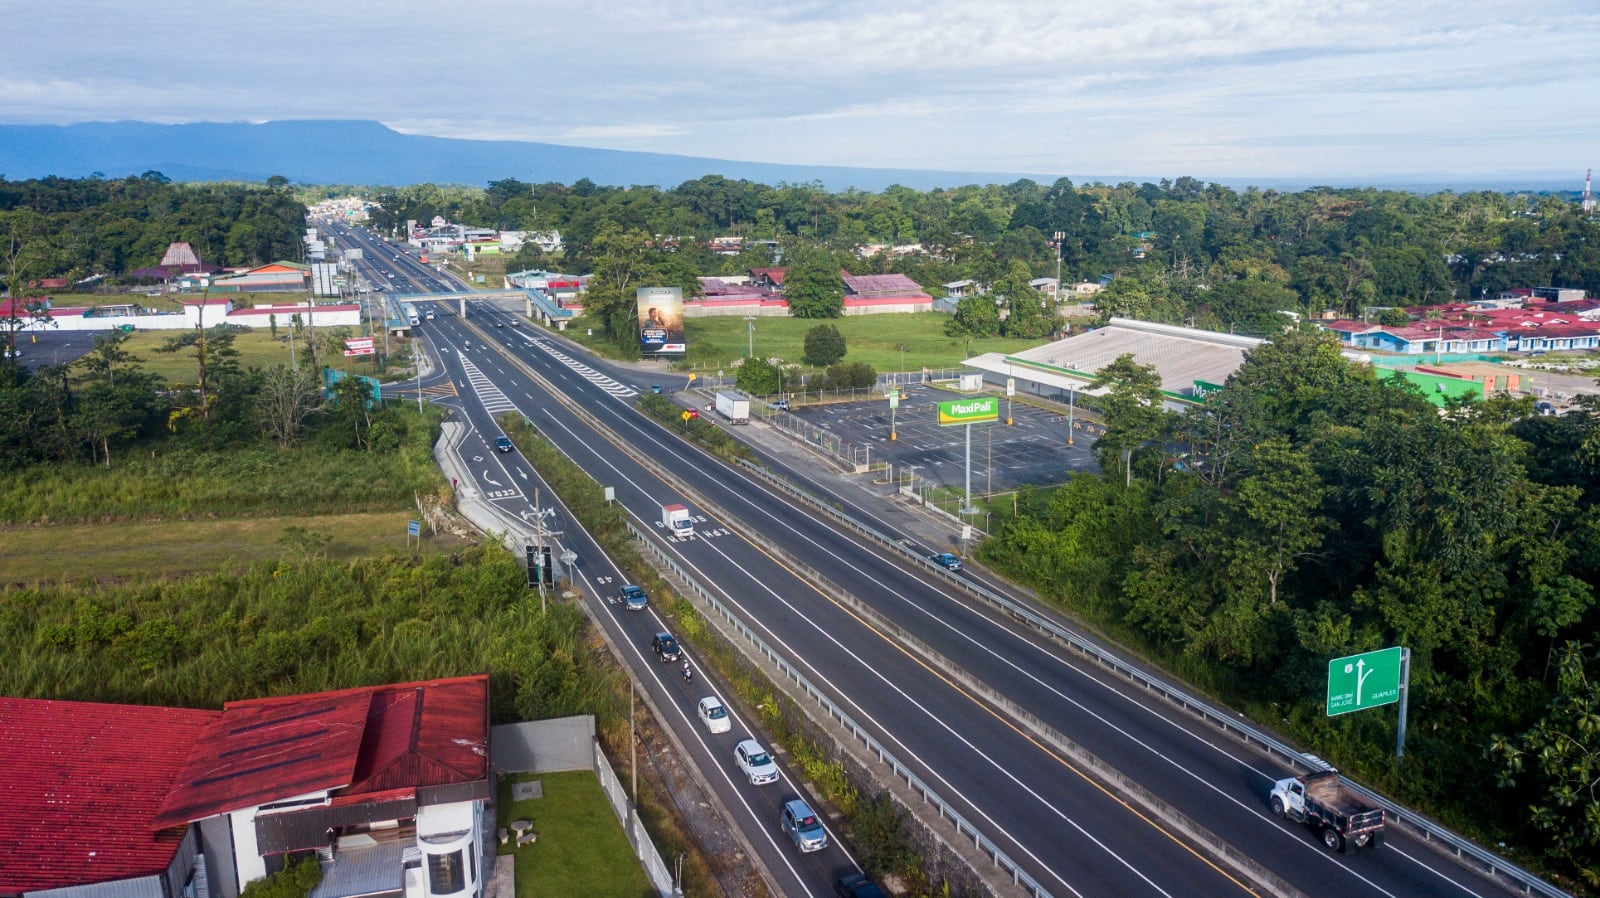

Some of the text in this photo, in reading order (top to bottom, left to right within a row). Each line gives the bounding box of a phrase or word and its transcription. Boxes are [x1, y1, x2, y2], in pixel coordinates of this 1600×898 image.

[487, 489, 515, 498] CEDA
[702, 528, 731, 538] KPH
[597, 576, 612, 585] 40
